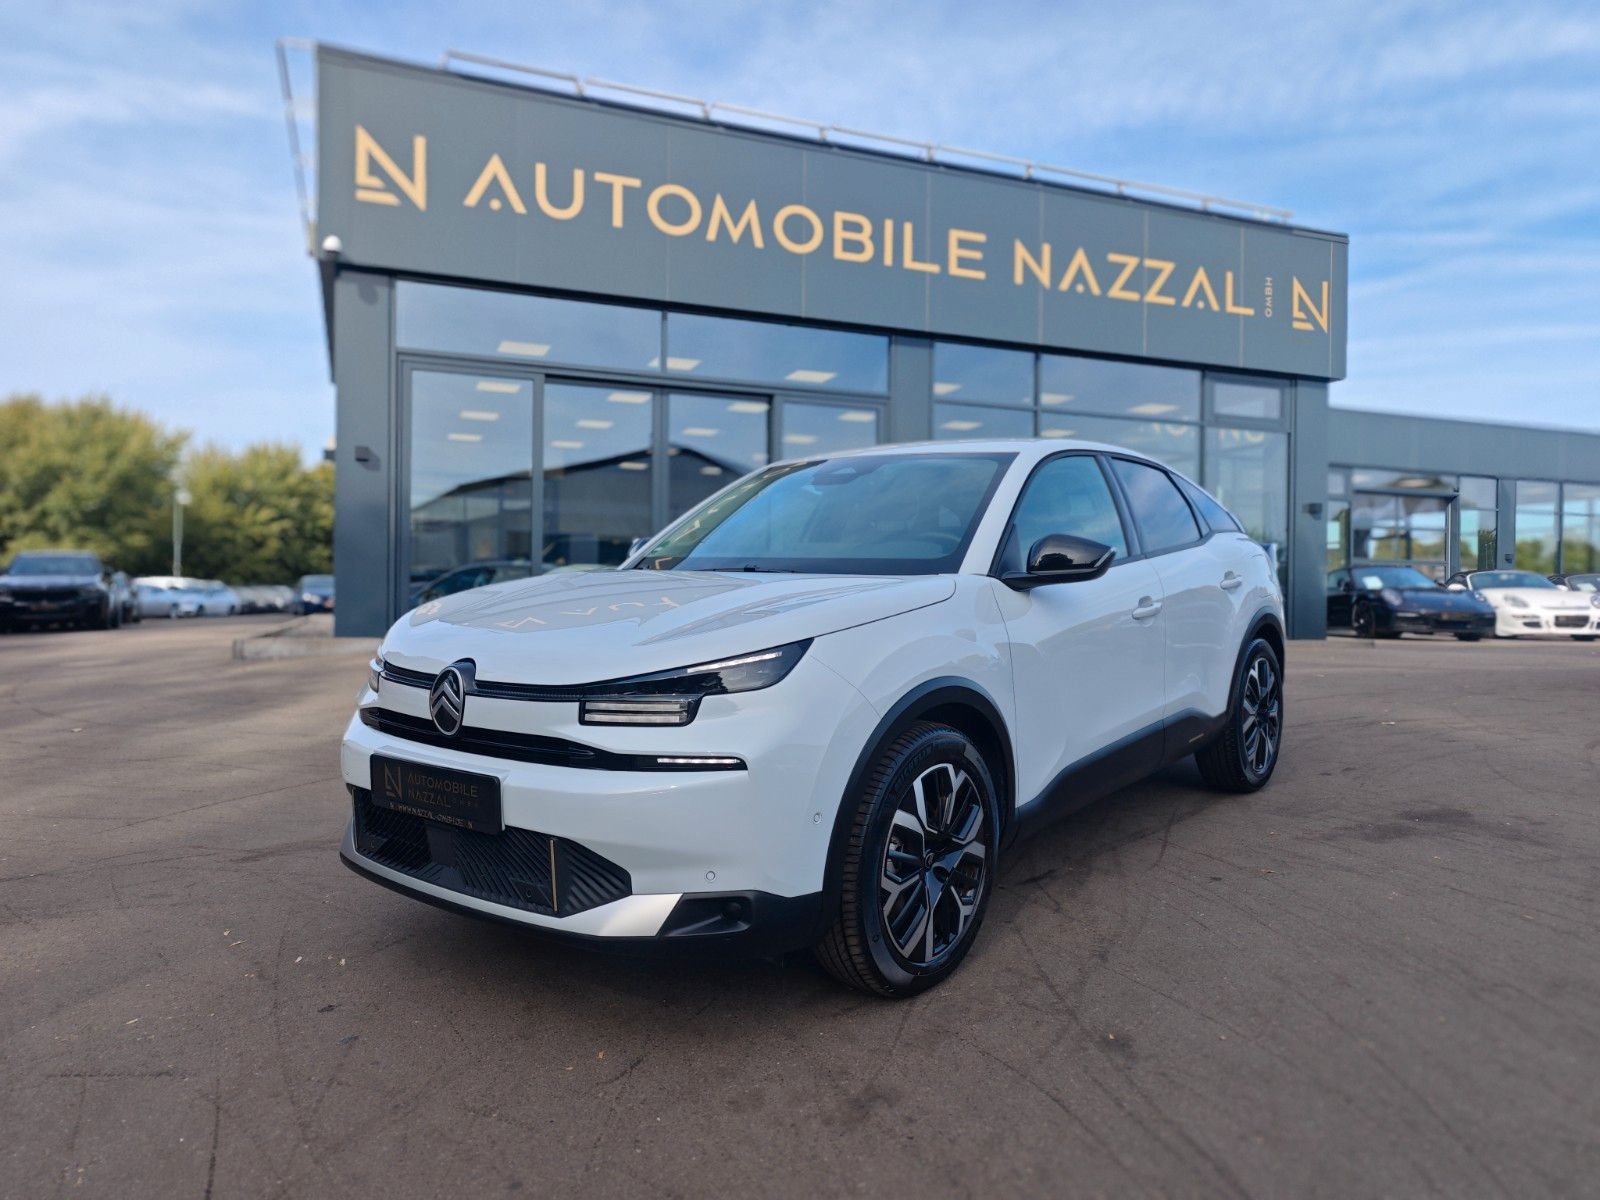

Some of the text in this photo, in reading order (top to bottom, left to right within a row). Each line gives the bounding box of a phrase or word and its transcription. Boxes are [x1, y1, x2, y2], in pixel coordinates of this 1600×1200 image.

[463, 152, 988, 281] AUTOMOBILE
[1012, 238, 1255, 317] NAZZAL
[407, 772, 479, 798] AUTOMOBILE
[408, 788, 452, 808] NAZZAL
